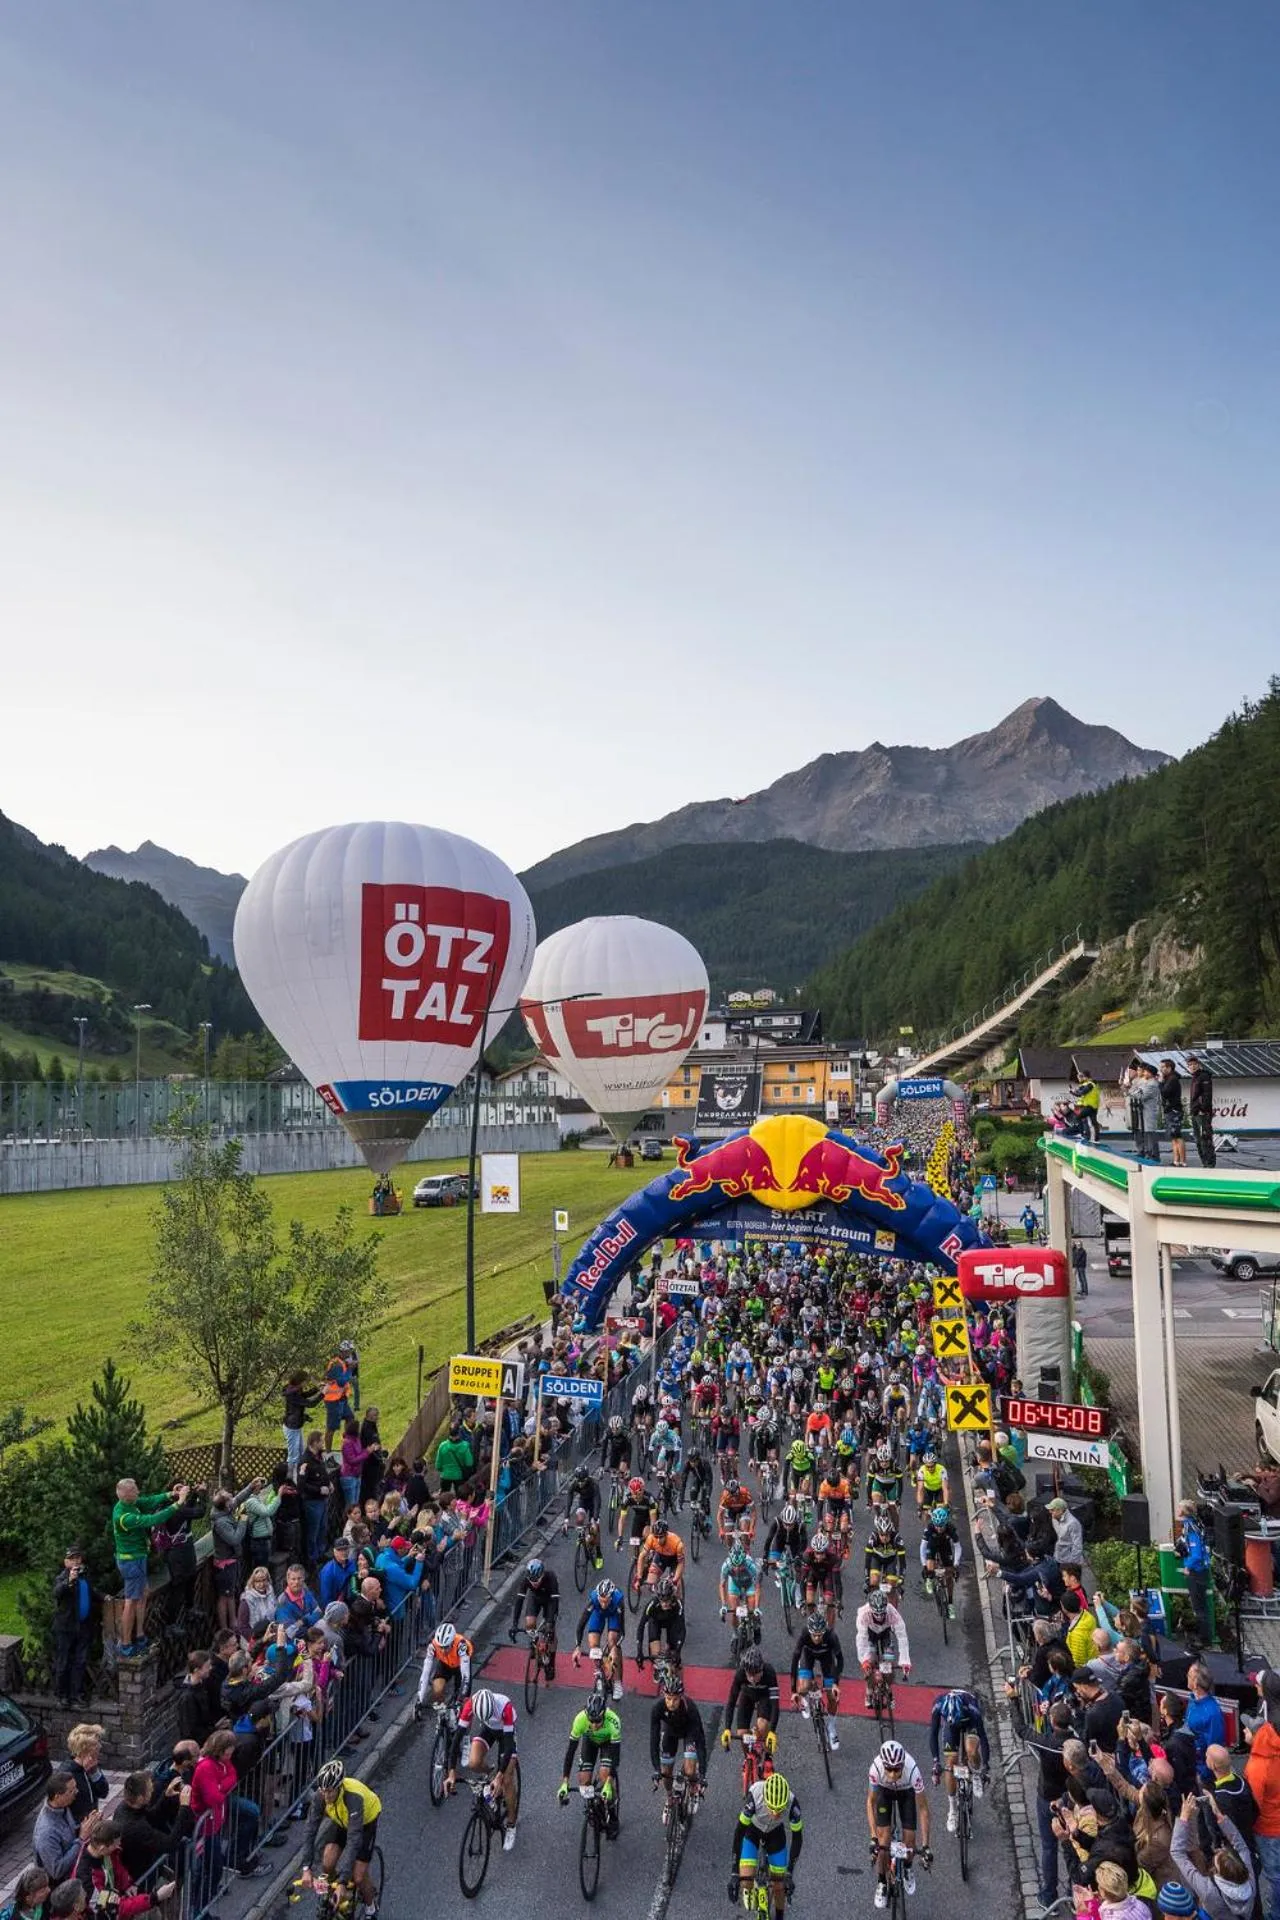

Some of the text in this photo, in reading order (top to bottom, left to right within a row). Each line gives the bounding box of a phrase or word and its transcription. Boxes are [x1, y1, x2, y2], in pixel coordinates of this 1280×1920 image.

[384, 903, 495, 974] ÖTZ
[381, 978, 474, 1025] TAL
[586, 1007, 696, 1050] Tirol
[368, 1087, 444, 1108] SÖLDEN
[900, 1083, 941, 1096] SÖLDEN
[771, 1209, 827, 1223] START
[830, 1225, 871, 1243] traum
[575, 1218, 638, 1292] Red Bull
[974, 1263, 1056, 1292] Tirol
[453, 1365, 499, 1379] GRUPPE 1
[502, 1368, 515, 1394] A
[453, 1379, 490, 1389] GRIGLIA
[546, 1380, 598, 1394] SÖLDEN
[1008, 1401, 1101, 1433] 06:45:08
[1034, 1445, 1101, 1465] GARMIN
